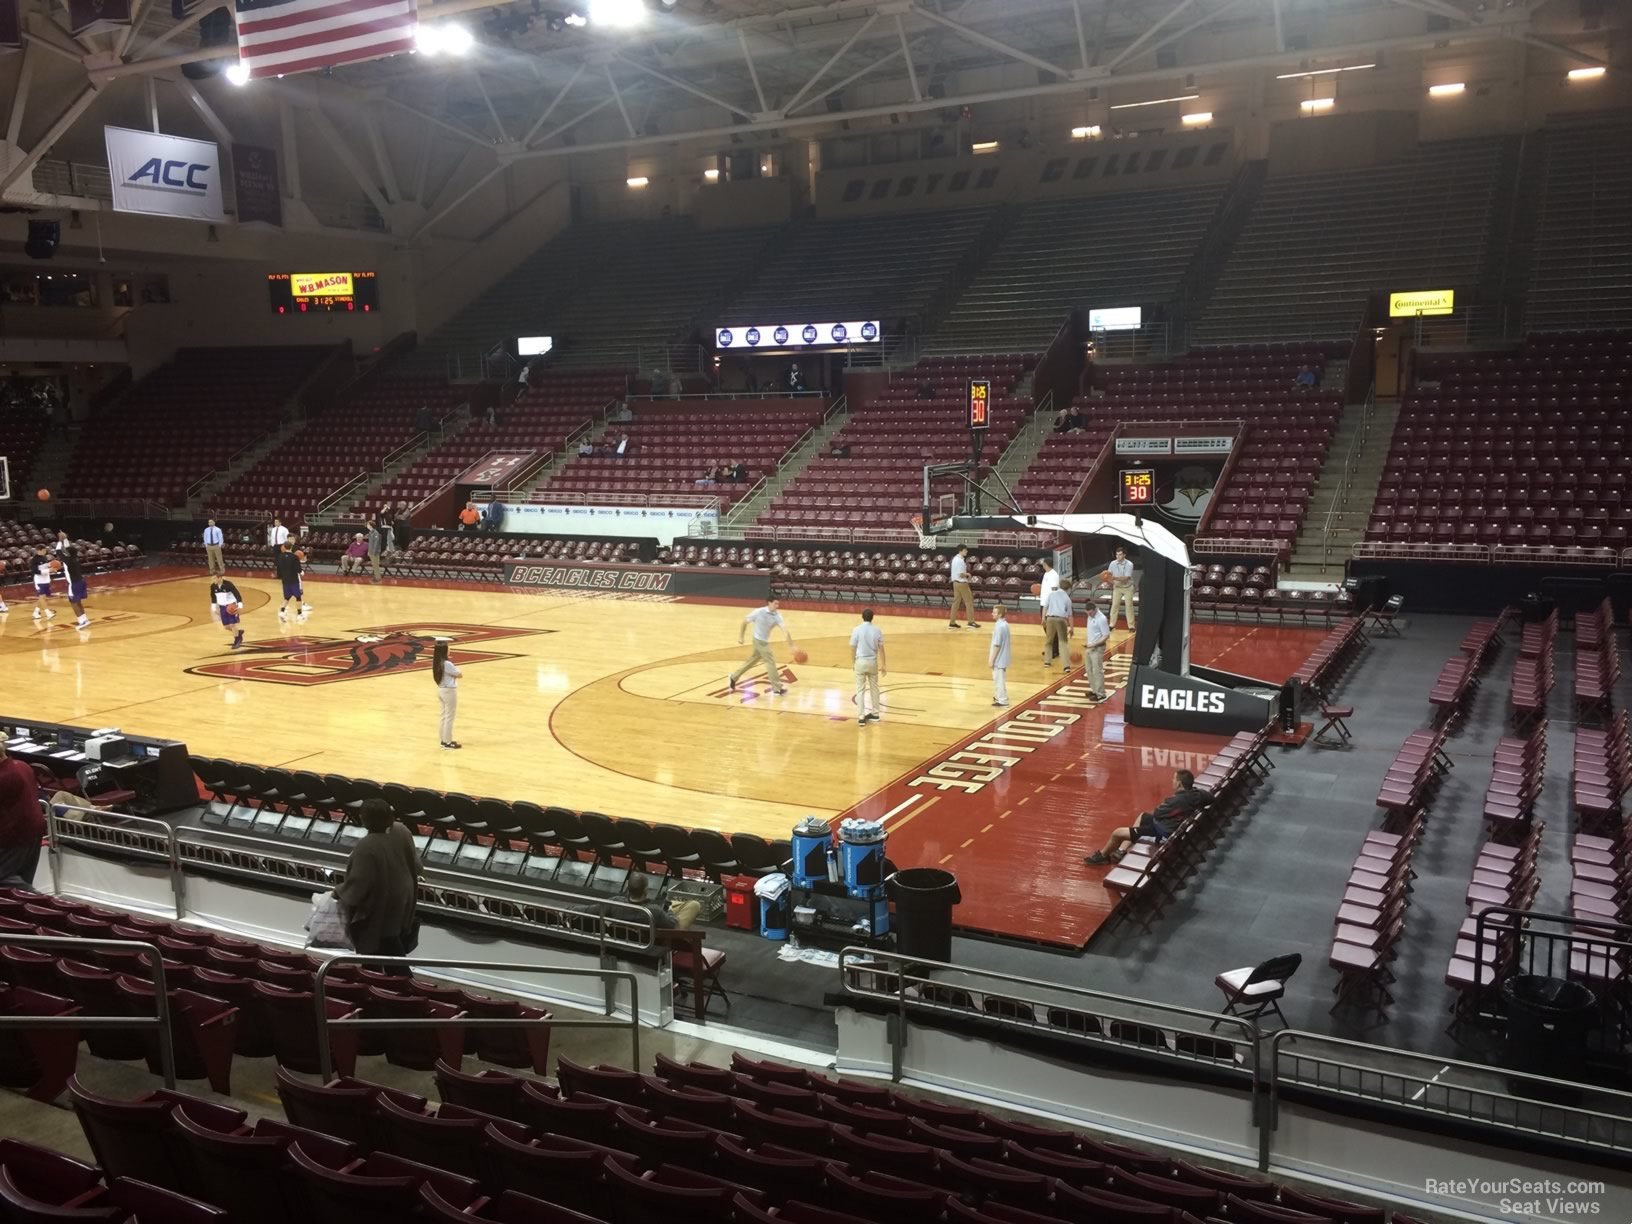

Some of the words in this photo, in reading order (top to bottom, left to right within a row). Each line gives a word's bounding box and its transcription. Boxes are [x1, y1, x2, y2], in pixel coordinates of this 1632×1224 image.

[128, 157, 211, 191] ACC
[1394, 299, 1441, 310] Continental
[973, 400, 985, 422] 30
[1125, 474, 1151, 486] 31:25
[1130, 486, 1147, 500] 30
[510, 565, 672, 591] BCEAGLES.COM
[1141, 684, 1226, 714] EAGLES
[907, 709, 1083, 794] COLLEGE
